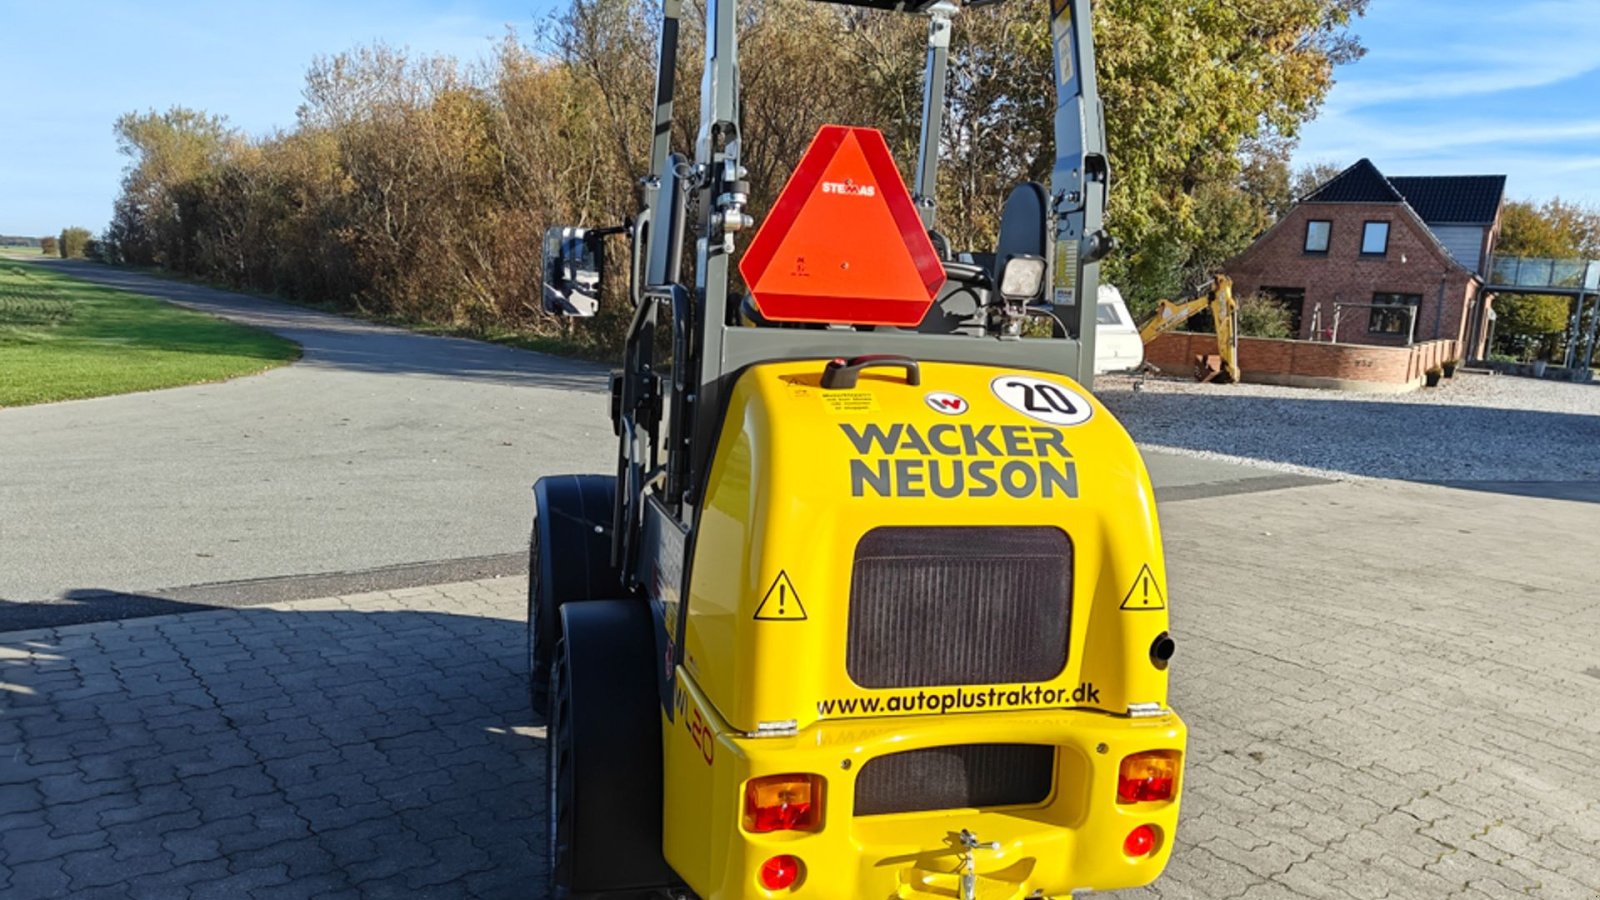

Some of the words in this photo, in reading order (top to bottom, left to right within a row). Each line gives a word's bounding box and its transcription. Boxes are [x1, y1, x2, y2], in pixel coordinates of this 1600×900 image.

[1006, 382, 1078, 415] 20
[838, 423, 1075, 458] WACKER
[849, 458, 1080, 499] NEUSON
[816, 683, 1101, 715] www.autoplustraktor.dk
